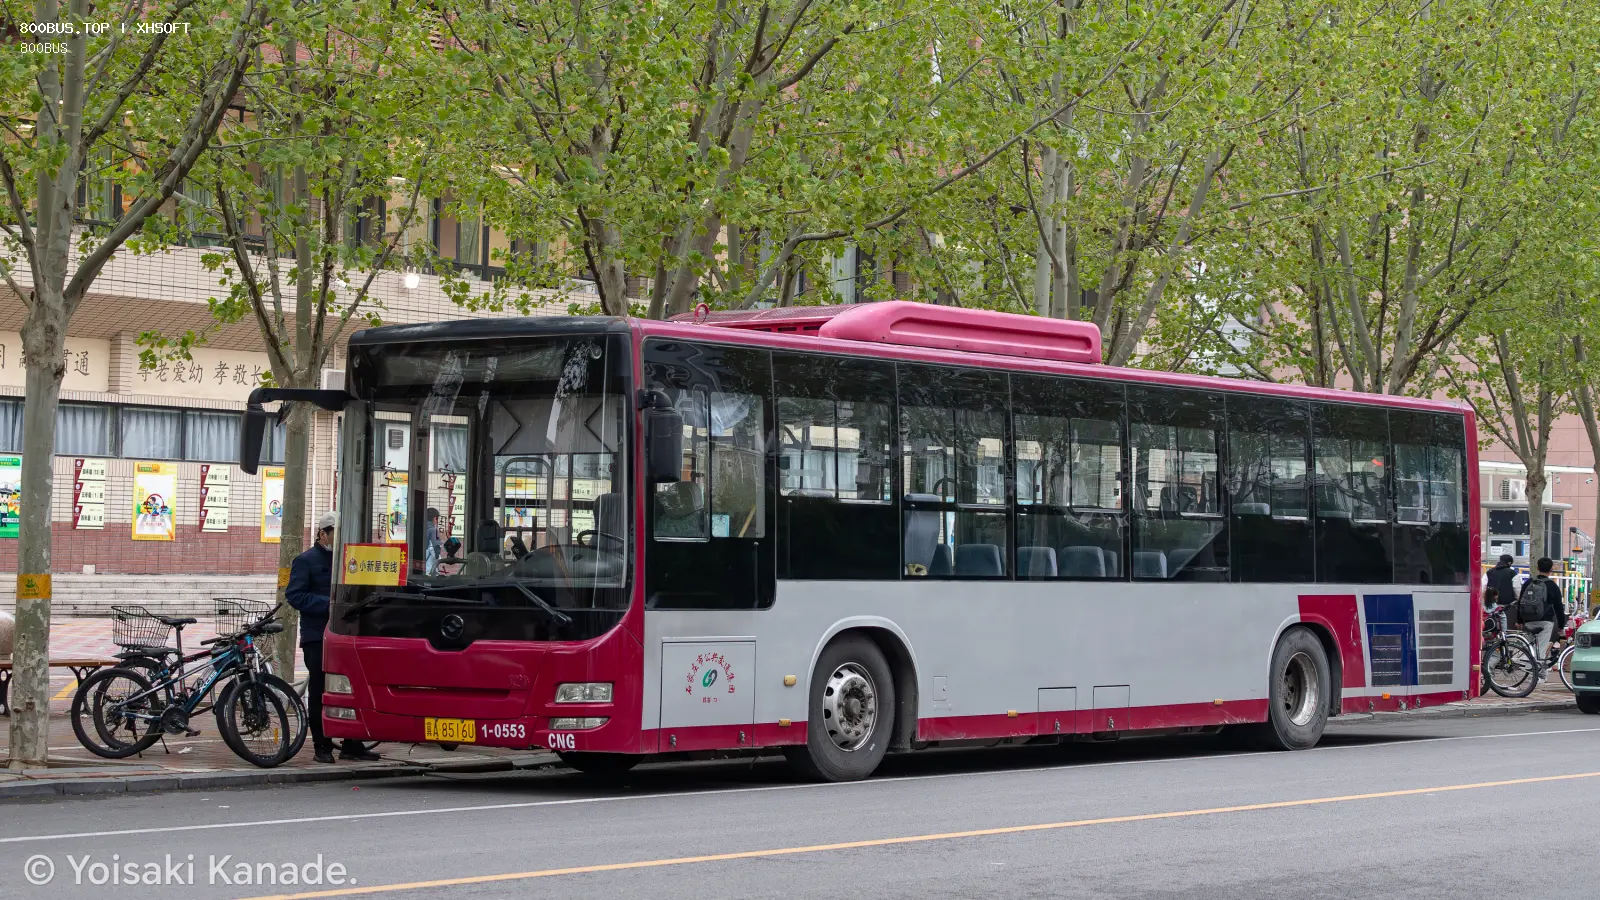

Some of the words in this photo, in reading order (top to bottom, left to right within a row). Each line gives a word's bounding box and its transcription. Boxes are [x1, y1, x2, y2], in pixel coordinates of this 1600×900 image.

[359, 560, 398, 574] 小新星专线
[481, 723, 526, 739] 1-0553
[548, 733, 576, 749] CNG
